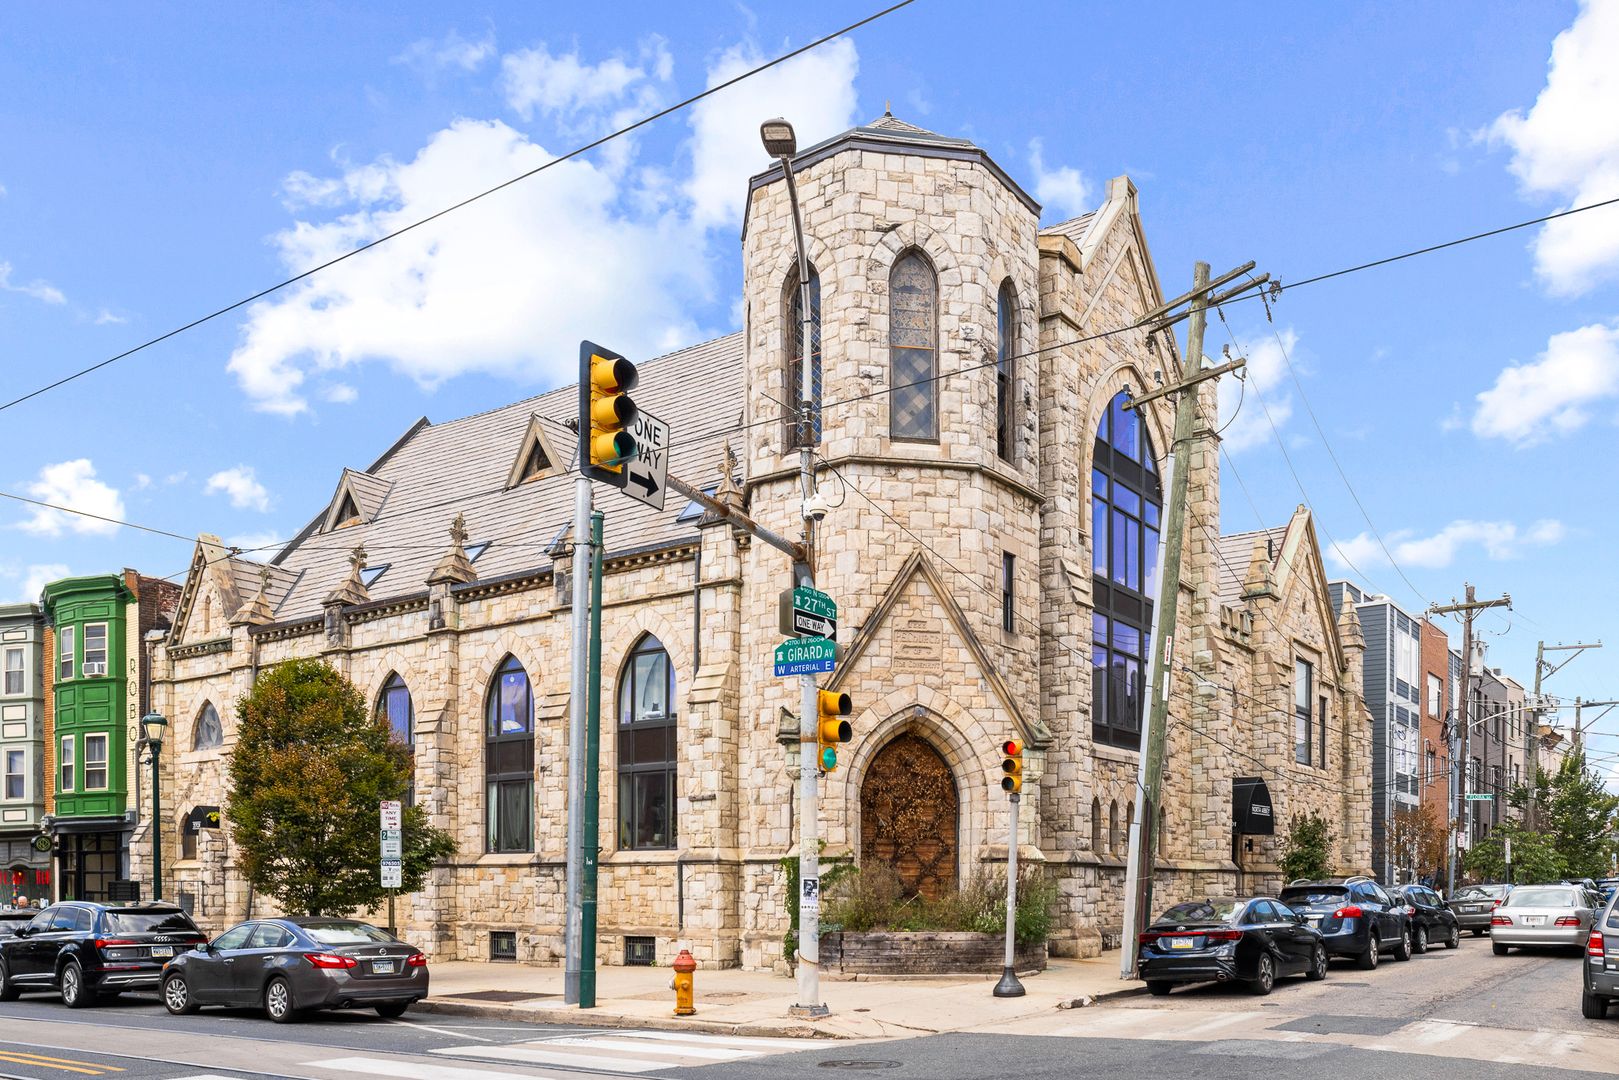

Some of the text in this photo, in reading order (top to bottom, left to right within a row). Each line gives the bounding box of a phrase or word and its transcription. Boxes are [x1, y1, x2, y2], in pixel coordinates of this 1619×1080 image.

[634, 418, 661, 447] ONE
[804, 596, 836, 618] 27TH ST
[800, 637, 808, 645] W
[787, 646, 834, 662] GIRARD AV
[777, 660, 831, 675] W ARTERIAL E
[129, 658, 137, 765] ROBOT
